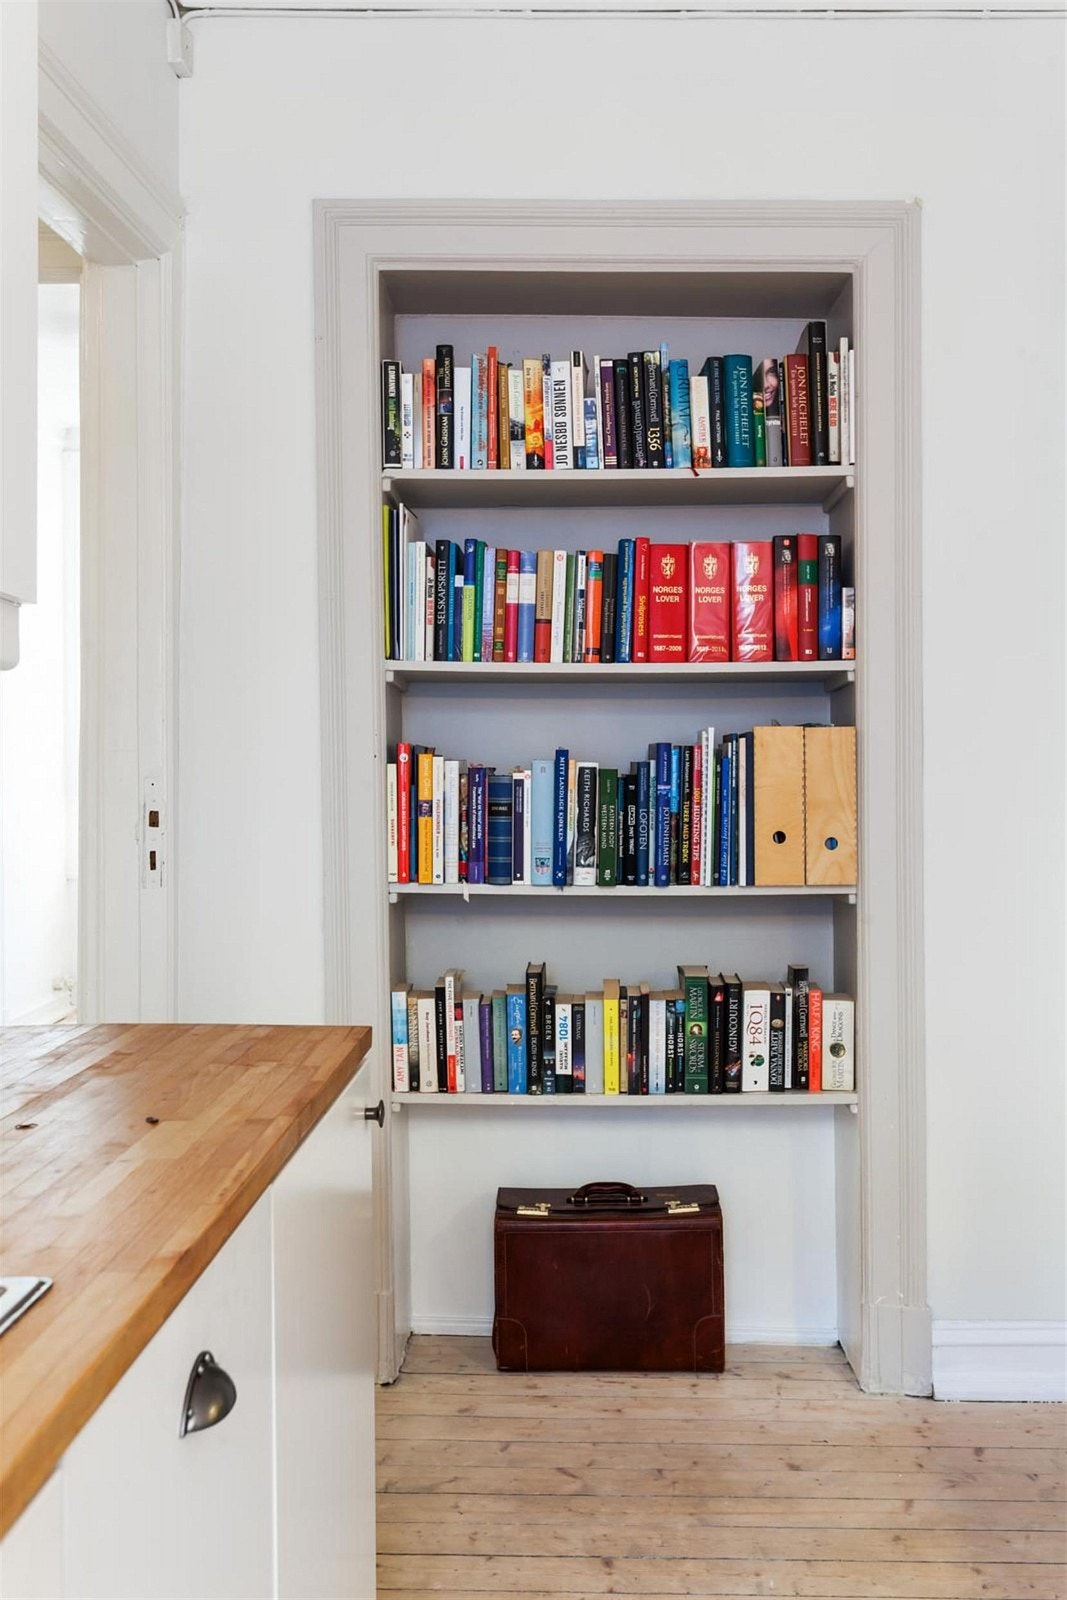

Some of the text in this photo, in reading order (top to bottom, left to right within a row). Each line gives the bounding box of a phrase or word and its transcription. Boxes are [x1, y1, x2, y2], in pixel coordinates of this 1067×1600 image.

[388, 366, 396, 397] ILDMANNEN
[648, 364, 660, 422] Bernard Cornwell
[554, 380, 568, 466] JO NESBØ SØNNEN
[737, 366, 750, 448] JON MICHELET
[795, 366, 808, 446] JON MICHELET
[440, 416, 449, 466] JOHN GRISHAM
[632, 400, 644, 458] Bernard Cornwell
[648, 427, 662, 450] 1356
[438, 560, 446, 625] SELSKAPSRETT
[640, 808, 648, 850] LOFOTEN
[513, 996, 522, 1024] Einstein
[529, 978, 538, 1005] Bernard
[799, 980, 808, 1037] Bernard Cornwell
[812, 992, 820, 1018] HALF
[530, 1005, 538, 1035] Cornwell
[559, 1016, 568, 1041] 1Q84
[728, 999, 738, 1053] AGINCOURT
[747, 1004, 763, 1046] 1Q84
[812, 1027, 820, 1052] KING
[689, 1039, 697, 1073] SWORDS
